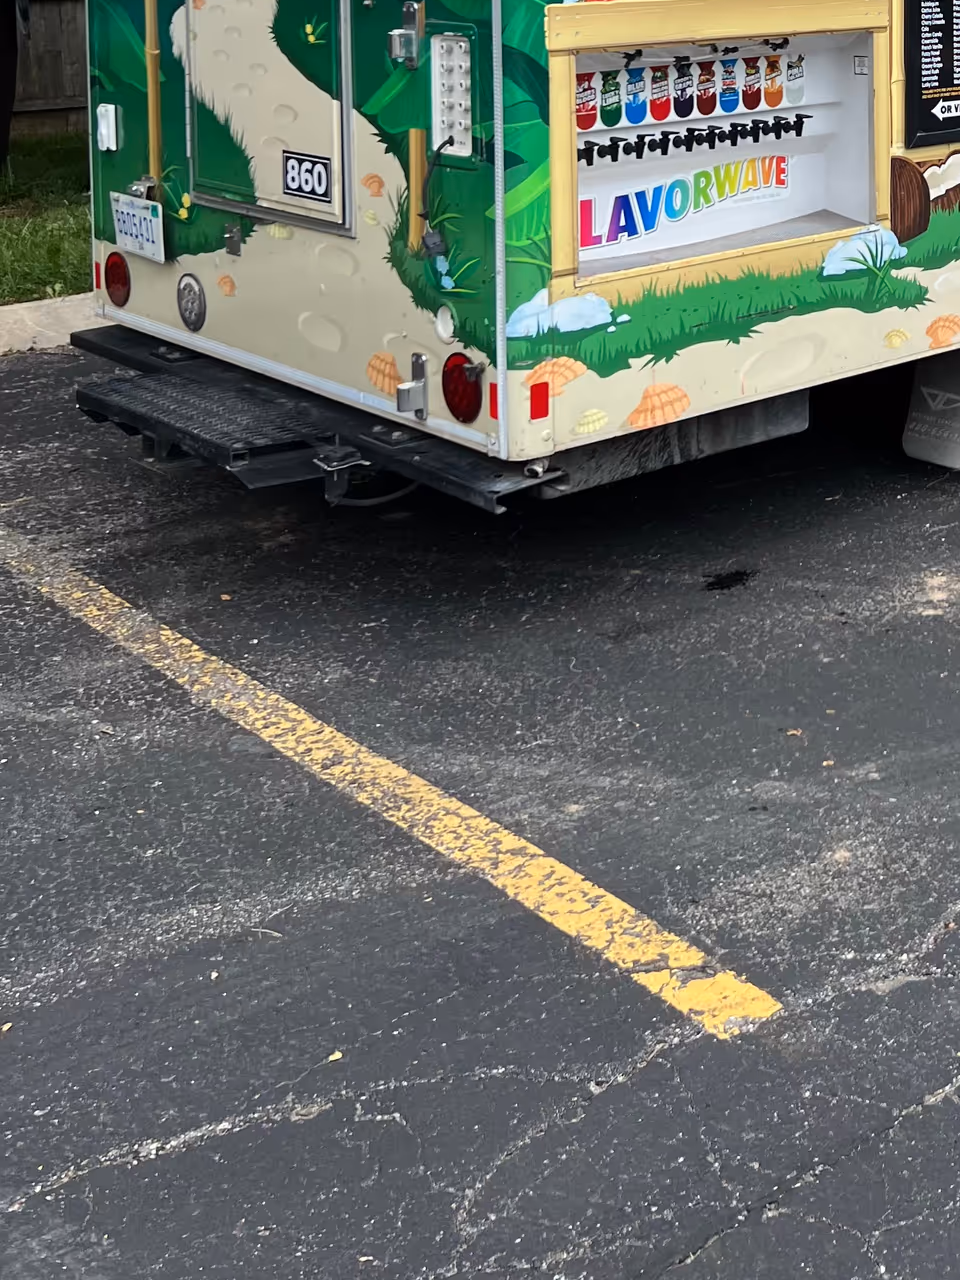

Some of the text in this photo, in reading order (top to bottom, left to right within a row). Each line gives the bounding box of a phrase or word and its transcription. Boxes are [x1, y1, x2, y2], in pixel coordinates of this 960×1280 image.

[627, 81, 645, 93] BLUE
[940, 105, 952, 115] OR
[287, 158, 328, 198] 860
